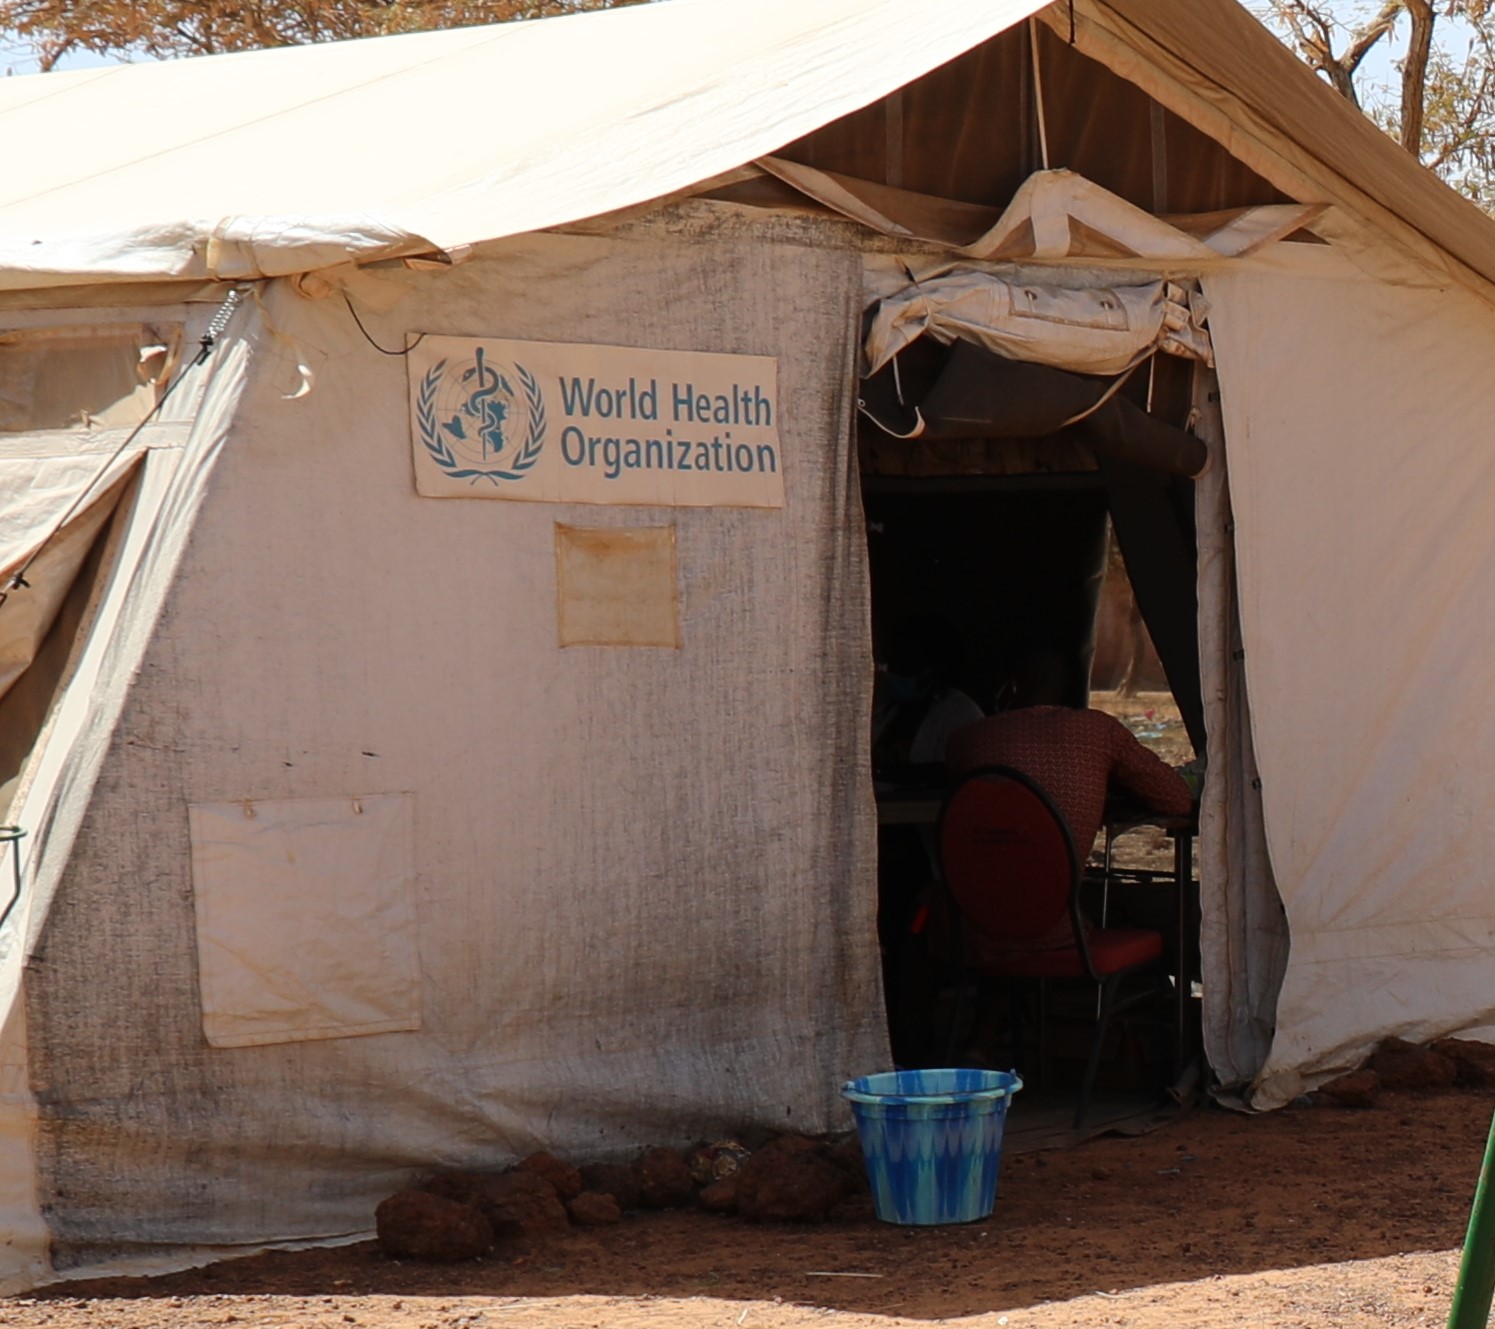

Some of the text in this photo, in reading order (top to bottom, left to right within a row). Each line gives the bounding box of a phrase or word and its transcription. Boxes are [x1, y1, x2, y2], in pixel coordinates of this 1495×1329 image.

[558, 376, 773, 426] World Health
[560, 425, 777, 479] Organization
